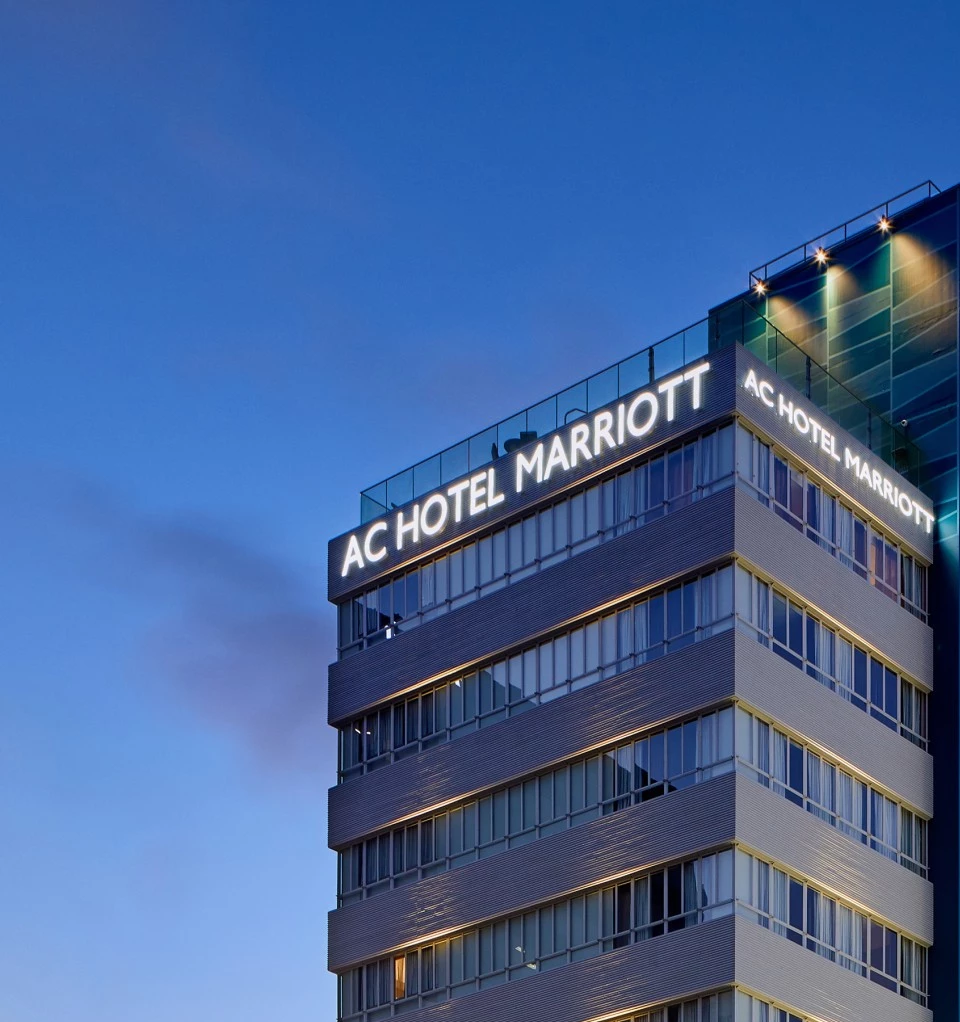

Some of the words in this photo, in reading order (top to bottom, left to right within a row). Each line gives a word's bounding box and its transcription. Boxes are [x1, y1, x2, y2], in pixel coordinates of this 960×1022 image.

[342, 520, 388, 578] AC
[395, 467, 505, 551] HOTEL
[514, 361, 711, 493] MARRIOTT
[744, 368, 775, 408] AC
[778, 393, 841, 462] HOTEL
[844, 446, 935, 534] MARRIOTT
